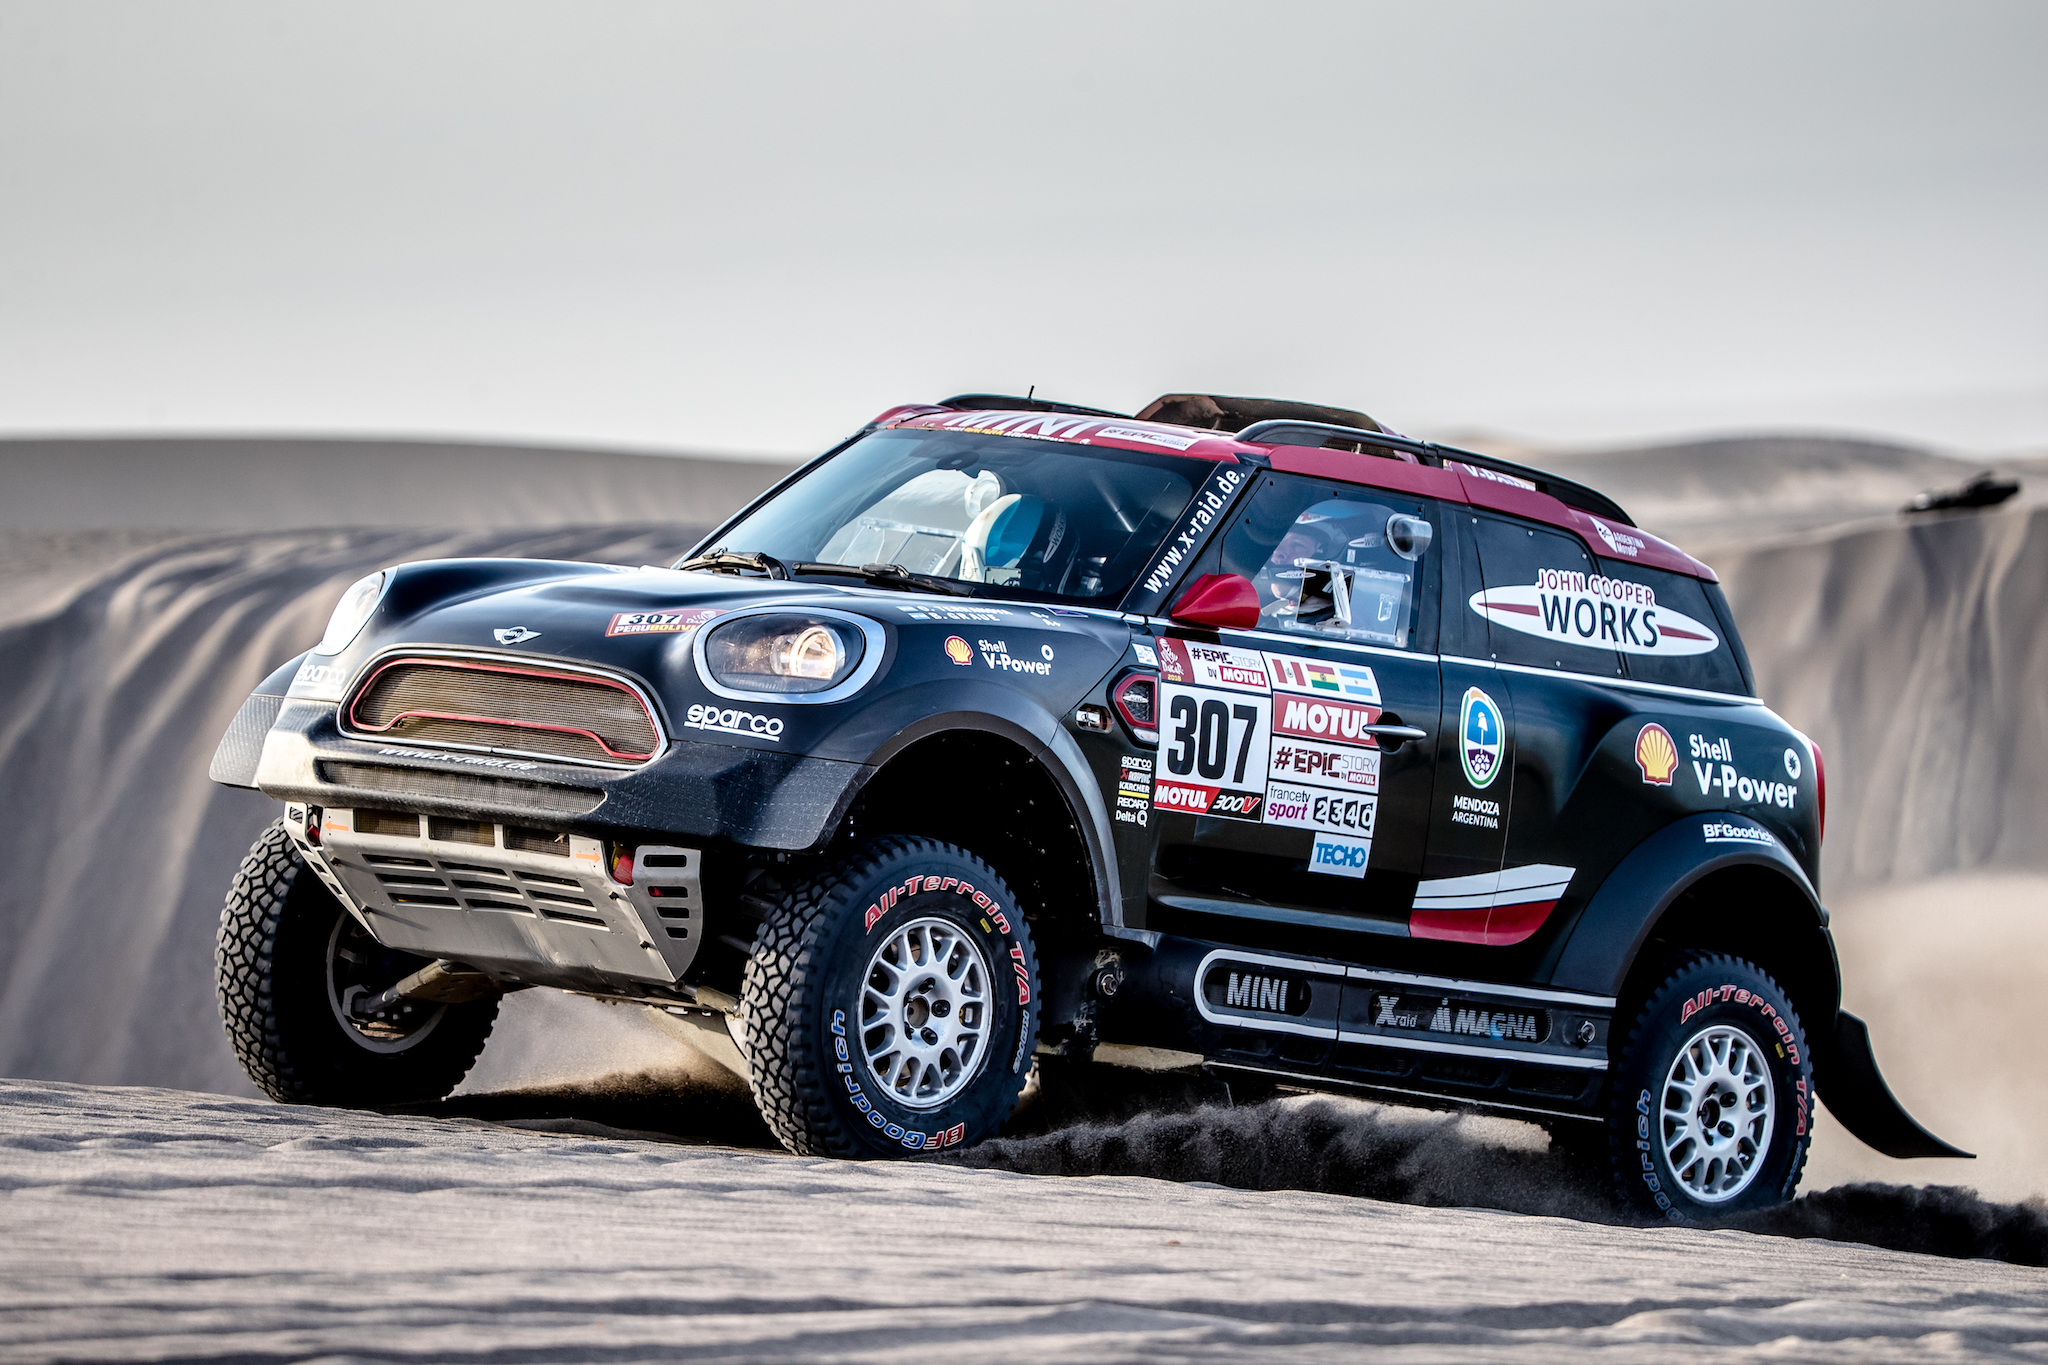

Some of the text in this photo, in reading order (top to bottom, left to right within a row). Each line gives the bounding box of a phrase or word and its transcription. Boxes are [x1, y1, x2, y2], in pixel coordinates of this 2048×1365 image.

[943, 411, 1103, 439] MINI
[1538, 571, 1654, 607] JOHN COOPER
[629, 614, 680, 624] 307
[949, 612, 1000, 622] GRAUE
[1540, 593, 1658, 648] WORKS
[614, 625, 698, 634] PERUBOLIVI
[978, 639, 1008, 653] Shell
[982, 652, 1052, 675] V-Power
[1231, 655, 1261, 668] STORY
[298, 665, 347, 685] sparco
[1206, 666, 1265, 685] by MOTUL
[684, 704, 784, 742] sparco
[1282, 701, 1372, 741] MOTUL
[1168, 694, 1258, 784] 307
[1689, 733, 1732, 763] Shell
[378, 748, 538, 770] www.x-raid.de
[1121, 756, 1152, 769] sparco
[1342, 755, 1378, 772] STORY
[1341, 772, 1375, 785] by MOTUL
[1692, 760, 1797, 809] V-Power
[1117, 796, 1149, 810] RECARO
[1154, 784, 1261, 813] MOTUL 300V
[1270, 785, 1311, 803] francetv
[1268, 802, 1308, 820] sport
[1453, 795, 1500, 816] MENDOZA
[1452, 811, 1499, 829] ARGENTINA
[1703, 823, 1776, 843] BFGoodrich
[1315, 841, 1367, 868] TECHO
[864, 874, 1011, 935] All-Terrain
[1009, 941, 1031, 1005] T/A
[1226, 973, 1288, 1012] MINI
[1454, 1009, 1538, 1041] MAGNA
[1680, 984, 1808, 1136] All-Terrain T/A
[830, 1008, 966, 1150] BFGoodrich
